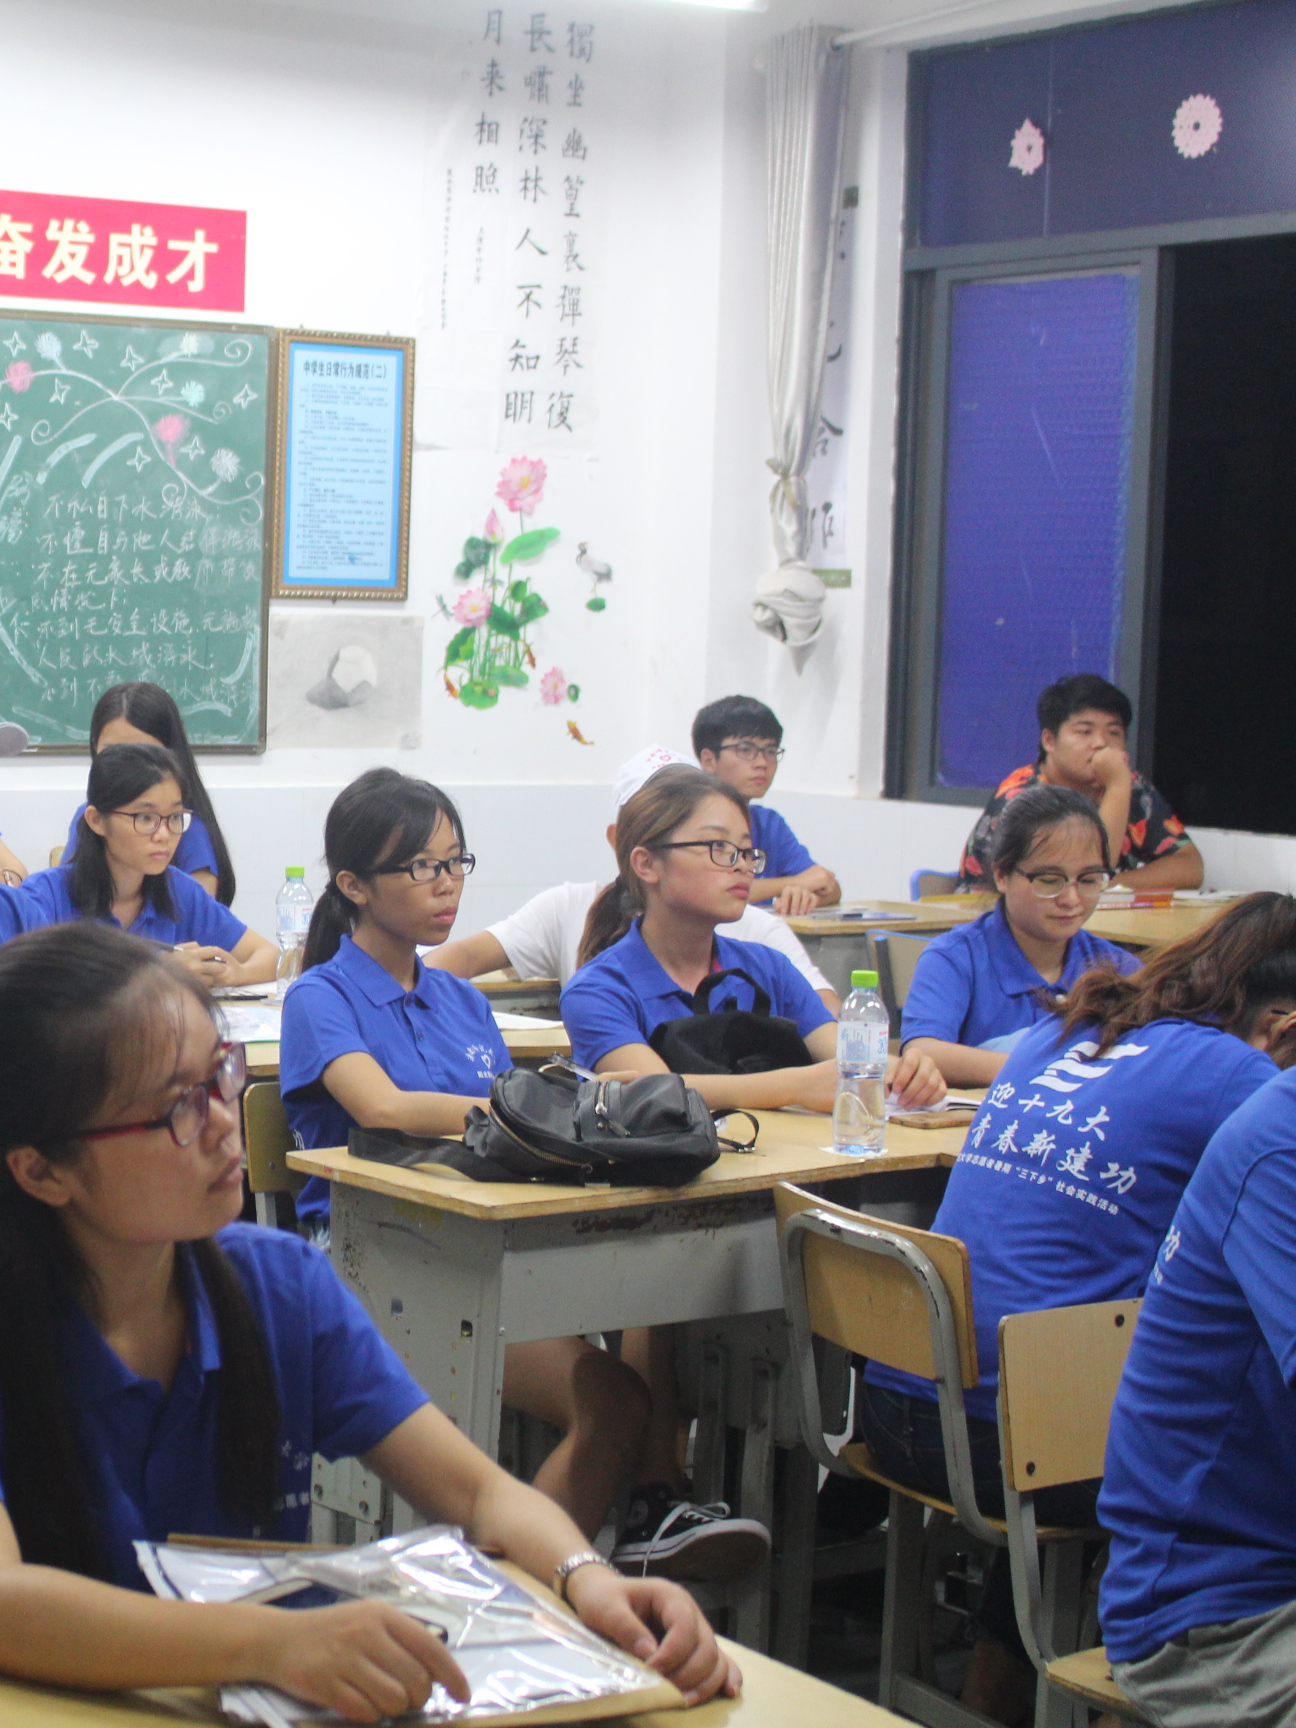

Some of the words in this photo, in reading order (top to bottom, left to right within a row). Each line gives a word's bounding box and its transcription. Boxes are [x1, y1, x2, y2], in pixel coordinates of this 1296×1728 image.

[303, 360, 387, 379] 中学生日常行为规范（二）
[987, 1081, 1111, 1141] 迎十九大
[970, 1112, 1138, 1195] 青春新建功
